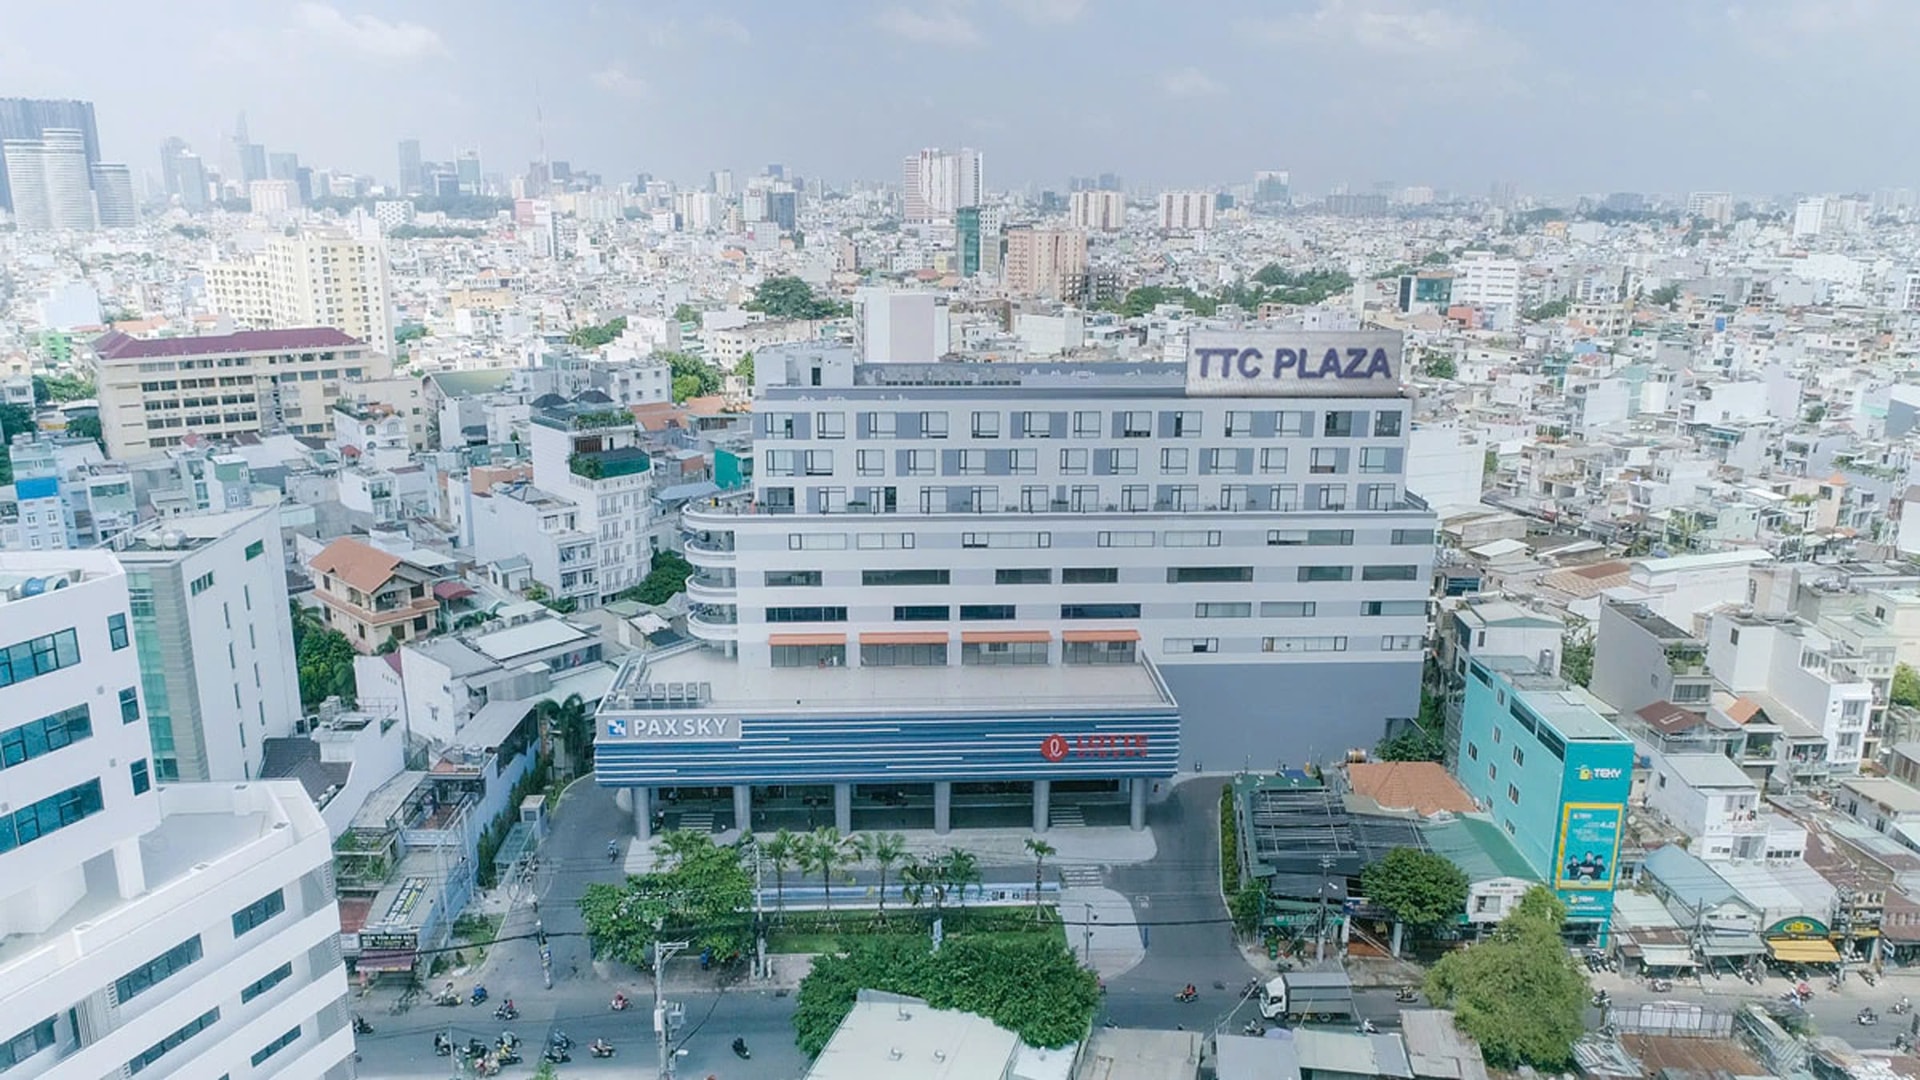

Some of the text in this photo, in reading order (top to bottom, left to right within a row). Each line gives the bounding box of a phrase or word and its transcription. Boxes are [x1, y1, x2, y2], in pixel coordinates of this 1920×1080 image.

[1195, 348, 1391, 378] TTC PLAZA
[634, 718, 727, 735] PAX SKY
